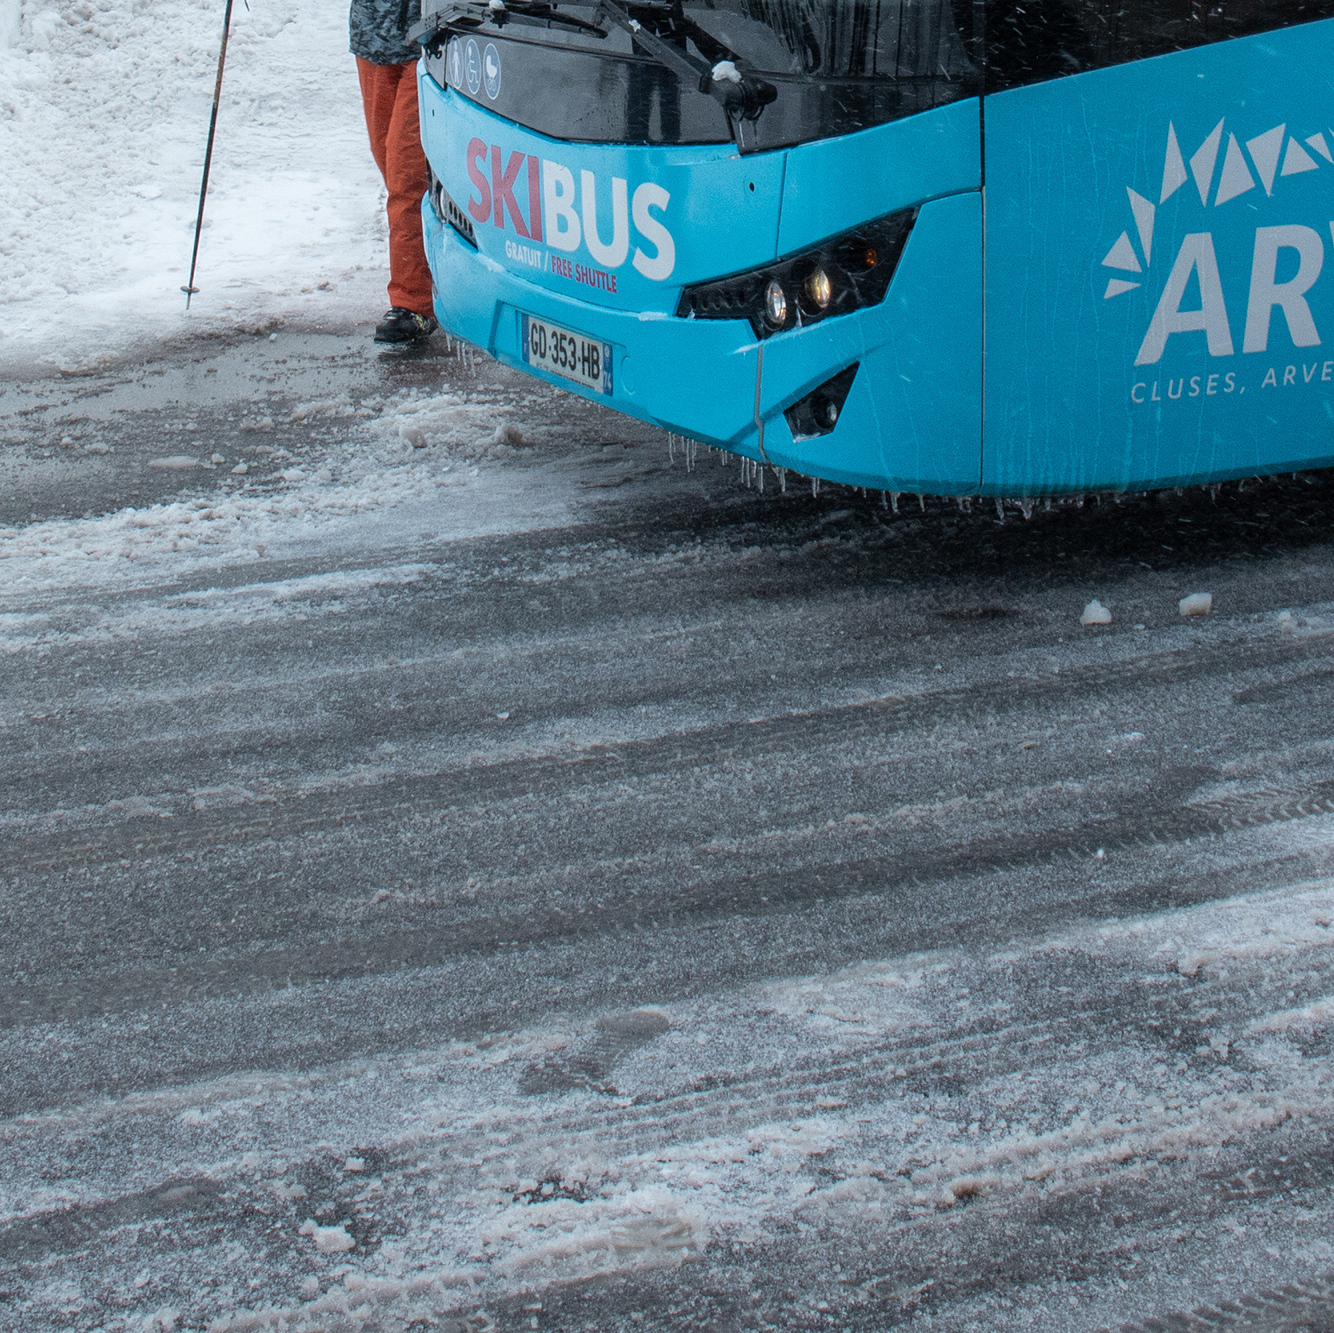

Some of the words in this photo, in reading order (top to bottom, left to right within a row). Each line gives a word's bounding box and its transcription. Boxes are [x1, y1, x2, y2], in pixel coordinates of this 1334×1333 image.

[467, 137, 675, 281] SKIBUS
[505, 240, 541, 269] GRATUIT
[551, 255, 573, 279] FREE
[575, 263, 617, 294] SHUTTLE
[1130, 372, 1246, 404] CLUSES,
[1261, 361, 1334, 388] ARVE
